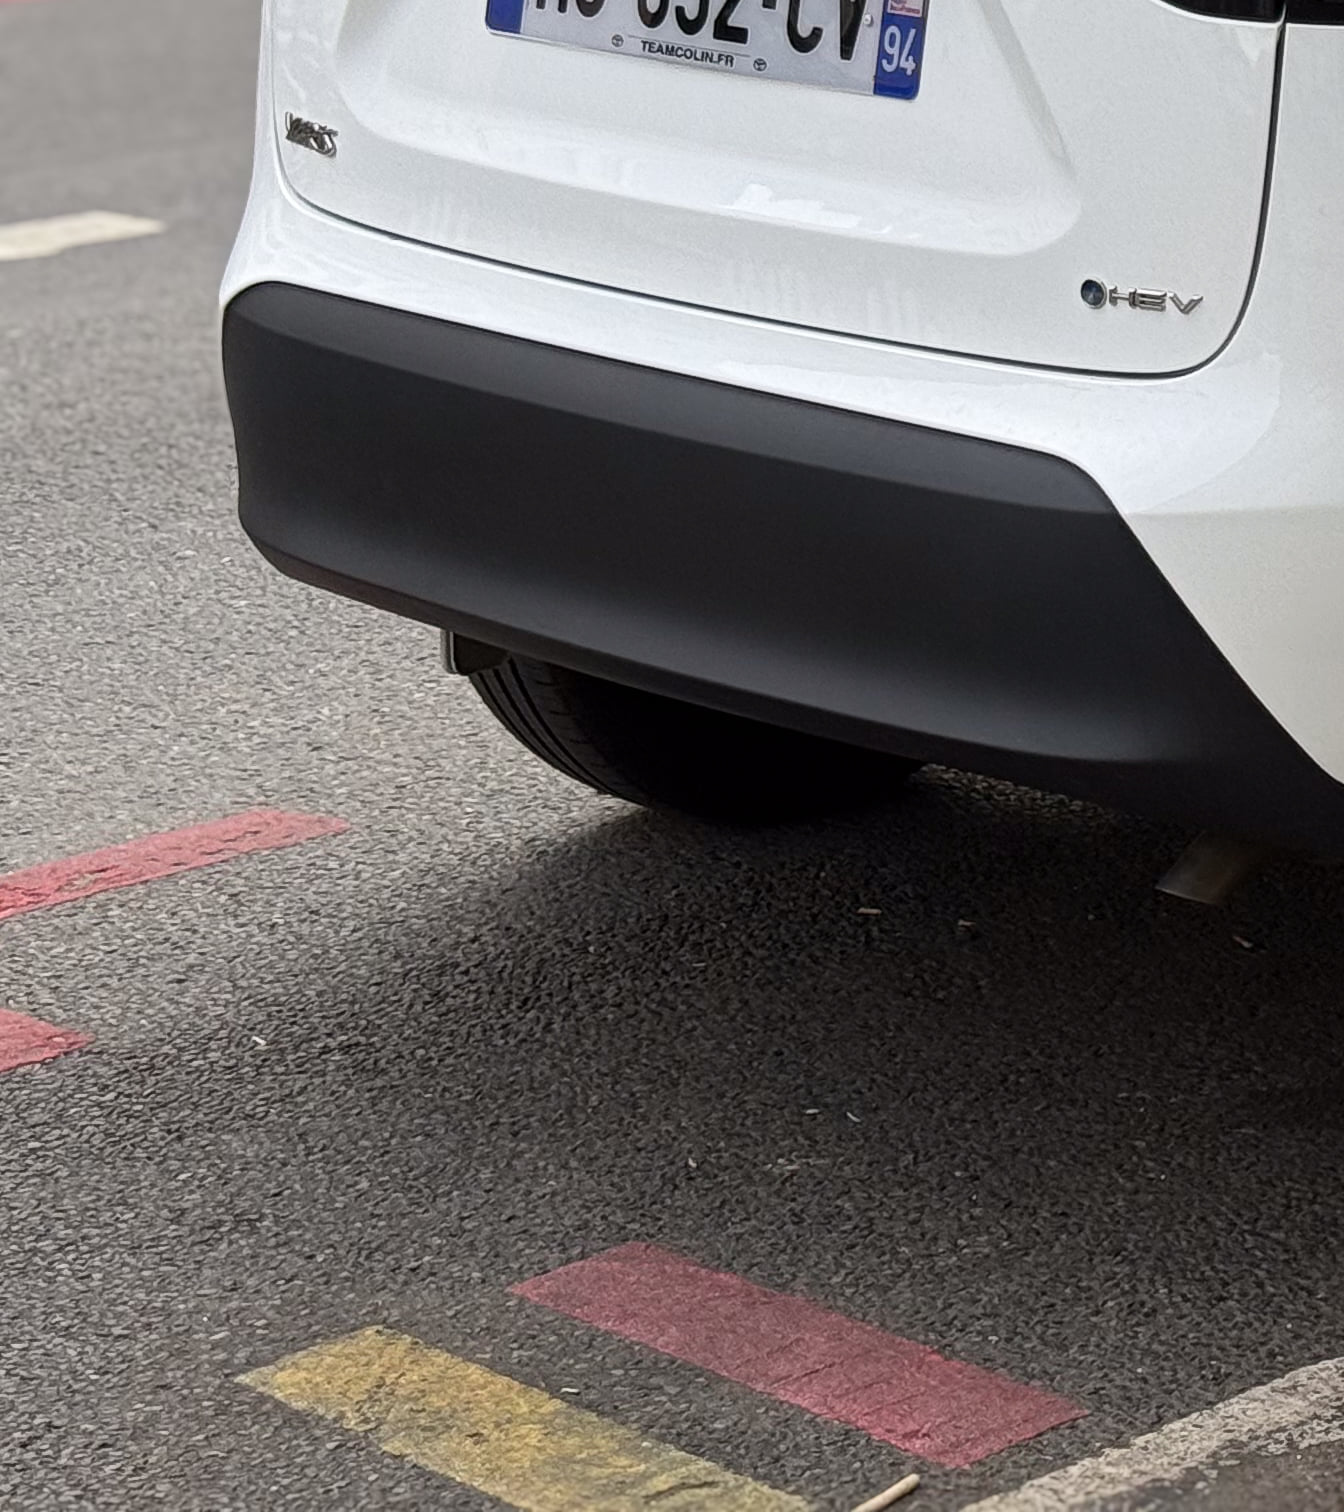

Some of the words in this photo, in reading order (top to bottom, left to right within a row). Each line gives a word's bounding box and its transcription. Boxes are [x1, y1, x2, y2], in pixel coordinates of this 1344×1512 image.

[640, 39, 735, 68] TEAMCOLIN.FR
[881, 25, 917, 76] 94
[1108, 284, 1204, 314] HEV
